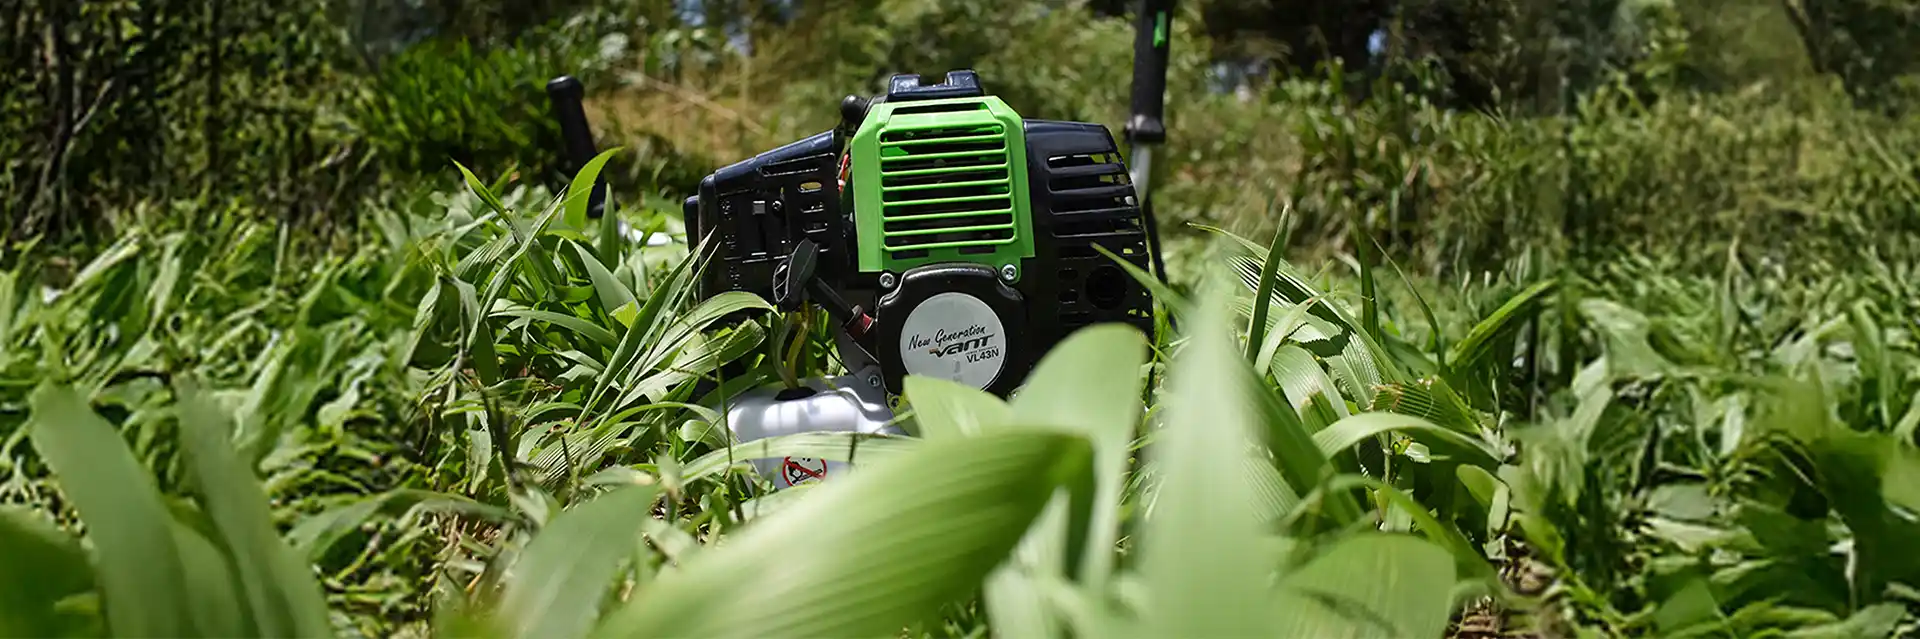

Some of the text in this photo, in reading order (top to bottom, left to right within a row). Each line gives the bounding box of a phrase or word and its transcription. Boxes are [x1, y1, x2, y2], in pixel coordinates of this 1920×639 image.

[908, 325, 986, 350] New Generation
[966, 348, 999, 363] VL43N
